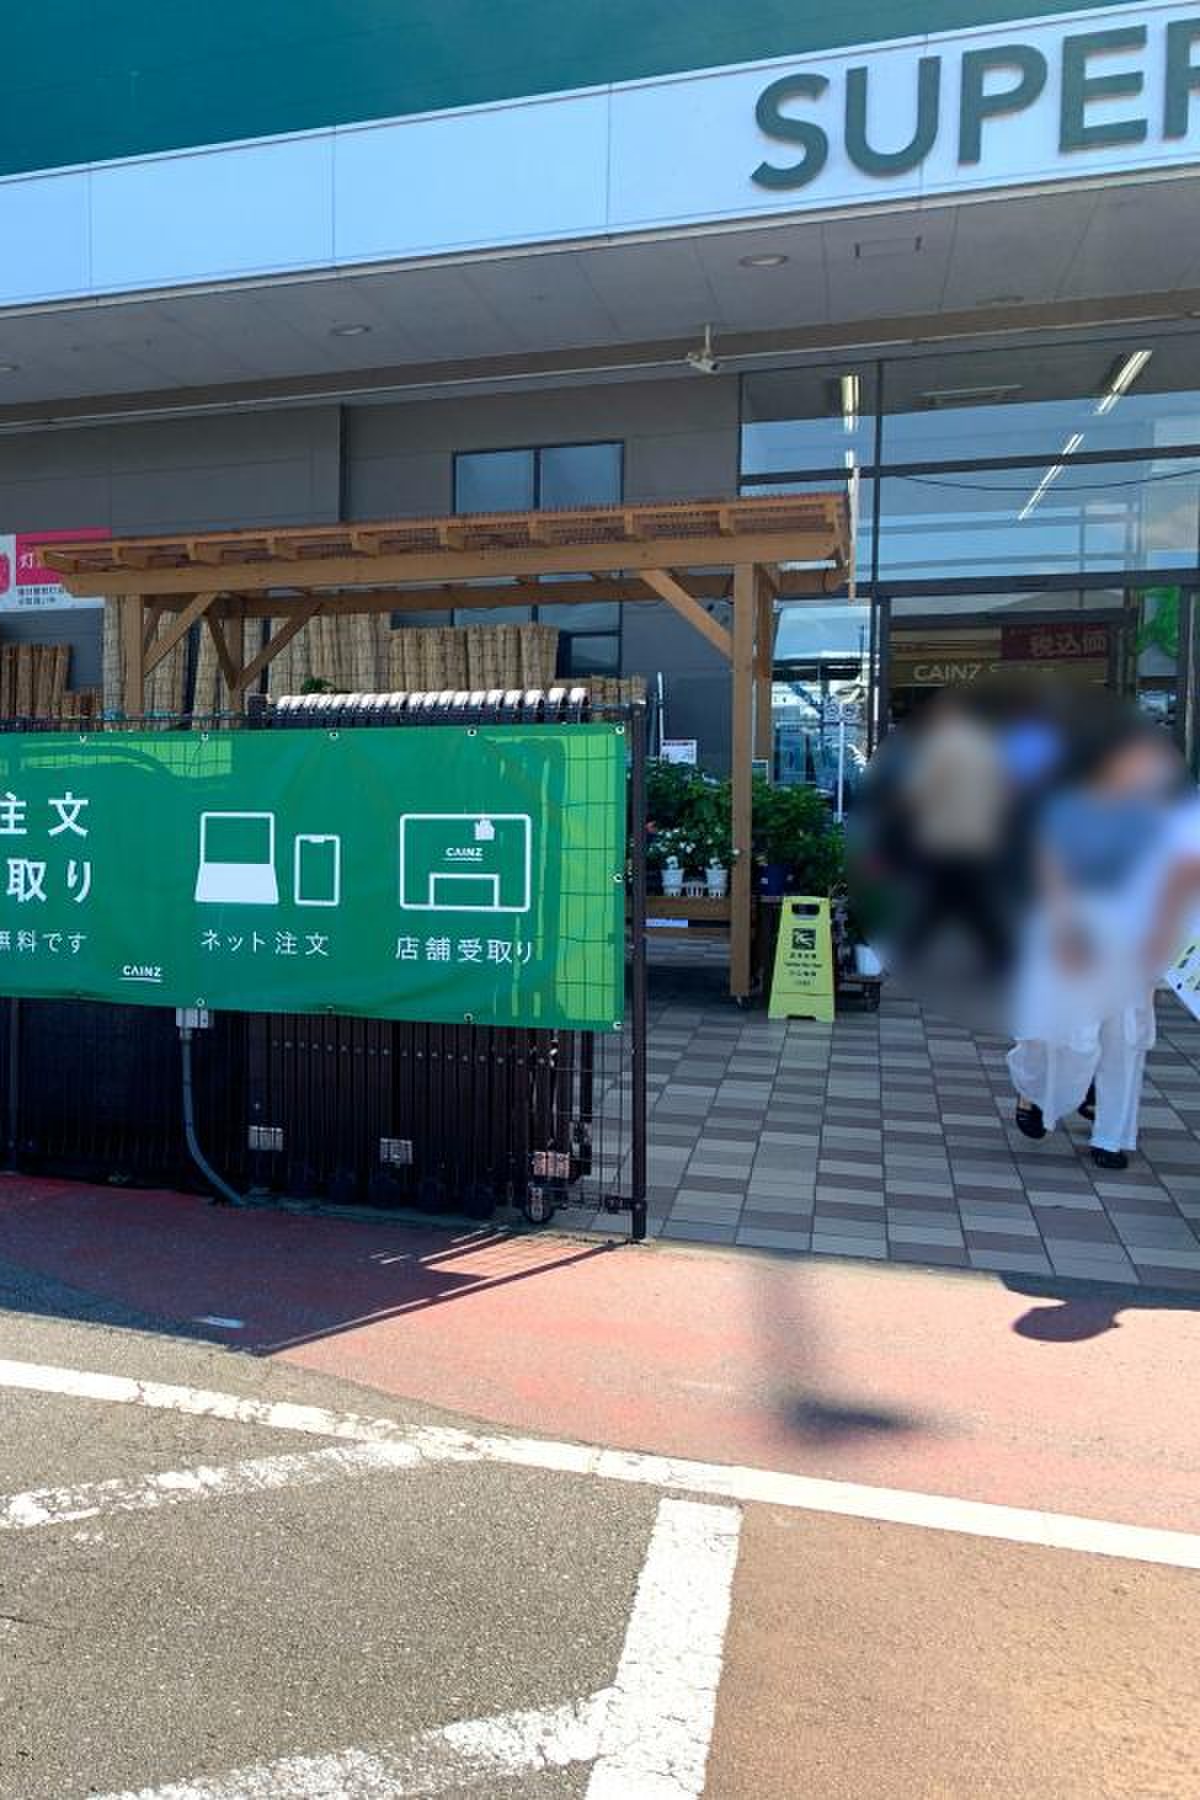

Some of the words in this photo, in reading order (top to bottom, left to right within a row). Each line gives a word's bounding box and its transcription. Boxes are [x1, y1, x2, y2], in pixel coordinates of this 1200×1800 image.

[445, 847, 483, 857] CAINZ
[200, 930, 329, 956] ネット注文
[395, 937, 533, 963] 店舗受取り
[122, 964, 162, 978] CAINZ
